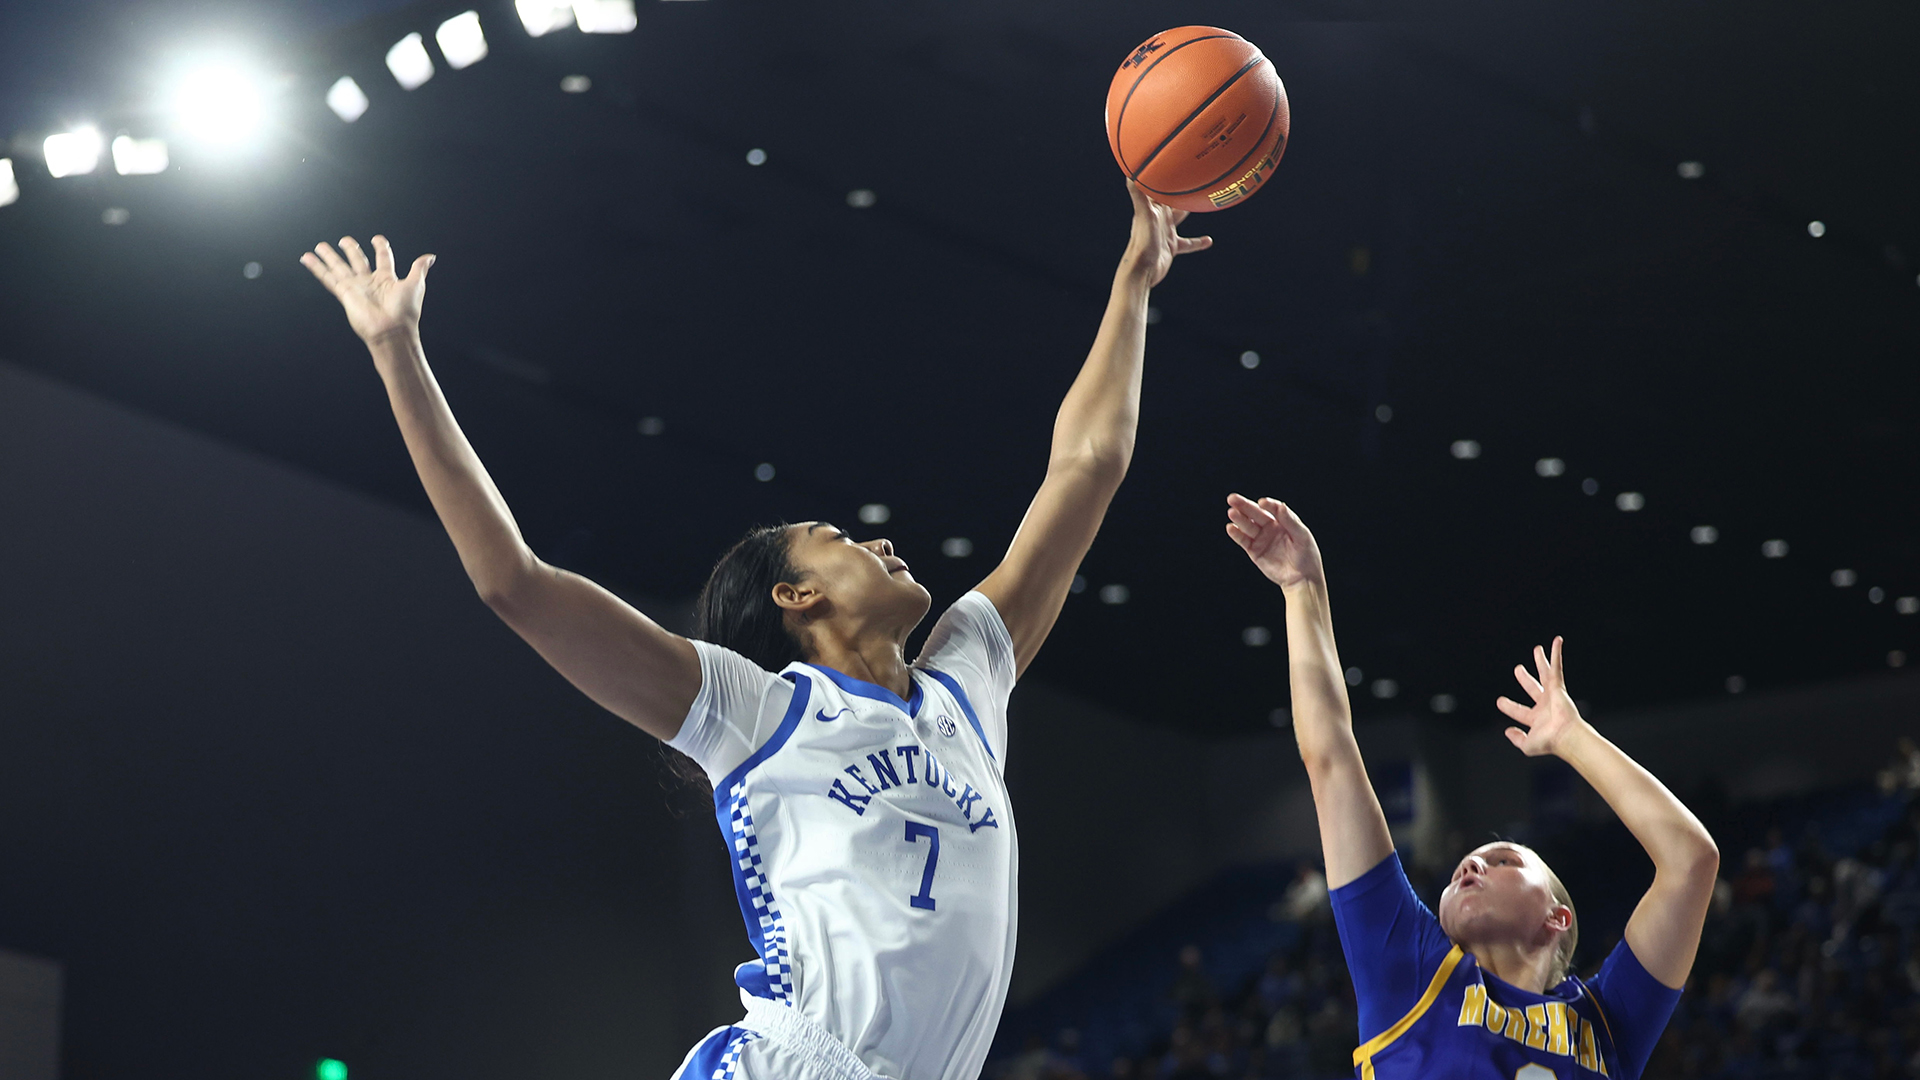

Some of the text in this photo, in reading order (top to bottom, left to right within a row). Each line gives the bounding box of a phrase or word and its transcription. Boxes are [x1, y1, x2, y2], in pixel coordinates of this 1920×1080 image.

[1209, 133, 1285, 208] ELITE
[938, 715, 956, 737] SEC
[828, 745, 998, 833] KENTUCKY
[904, 820, 940, 911] 7
[1458, 983, 1609, 1079] MOREHEA
